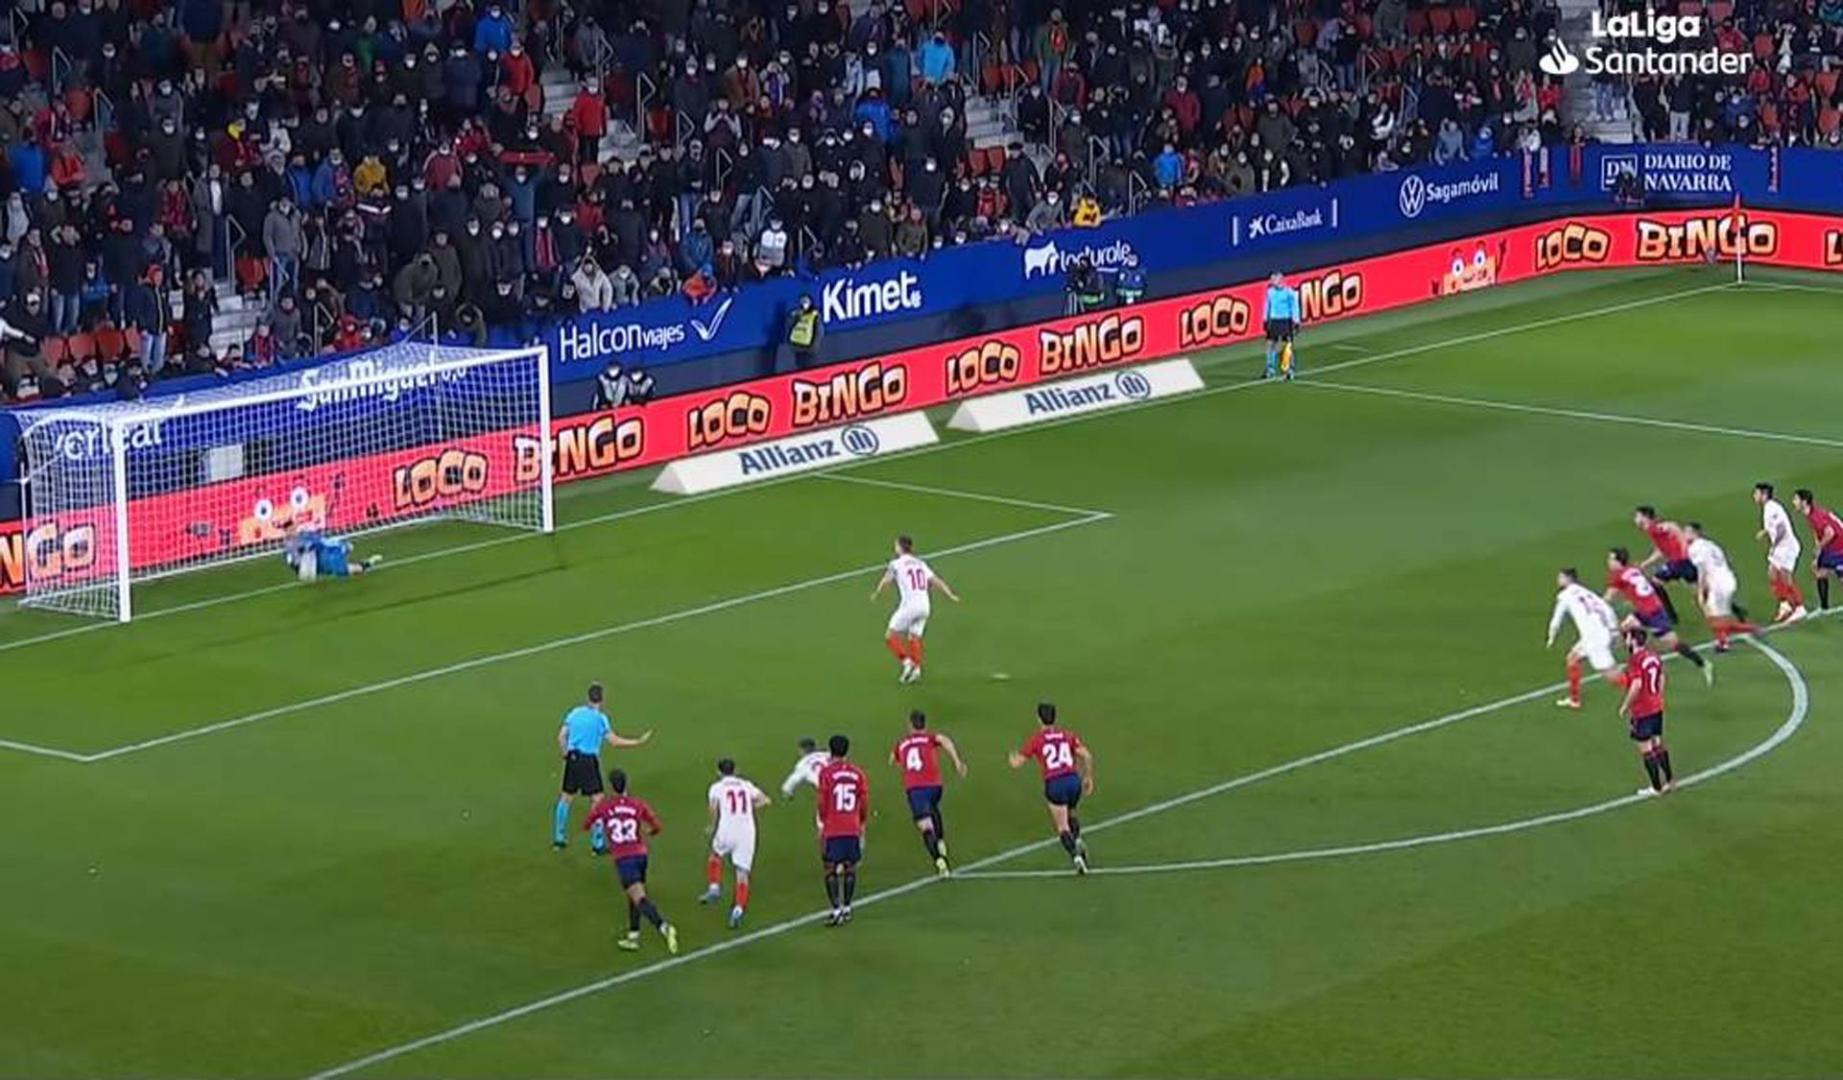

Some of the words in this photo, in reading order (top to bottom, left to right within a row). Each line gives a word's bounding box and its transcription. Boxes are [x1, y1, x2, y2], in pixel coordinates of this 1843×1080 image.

[1644, 154, 1706, 171] DIARIO
[1709, 154, 1732, 172] DE
[1426, 172, 1498, 203] Sagamóvil
[1644, 173, 1732, 192] NAVARRA
[1265, 208, 1323, 235] CaixaBank
[1537, 223, 1609, 270] LOCO
[1636, 213, 1776, 260] BINGO
[823, 271, 918, 323] Kimet
[1300, 271, 1362, 320] NGO
[1180, 296, 1249, 347] LOCO
[946, 341, 1021, 396] LOCO
[1040, 314, 1143, 374] BINGO
[688, 392, 771, 450] LOCO
[793, 363, 907, 426] BINGO
[1024, 382, 1115, 415] Allianz
[739, 438, 840, 475] Allianz
[394, 450, 488, 510] LOCO
[907, 568, 927, 591] 10
[906, 747, 923, 771] 4
[1042, 742, 1073, 770] 24
[726, 789, 748, 815] 11
[832, 783, 856, 812] 15
